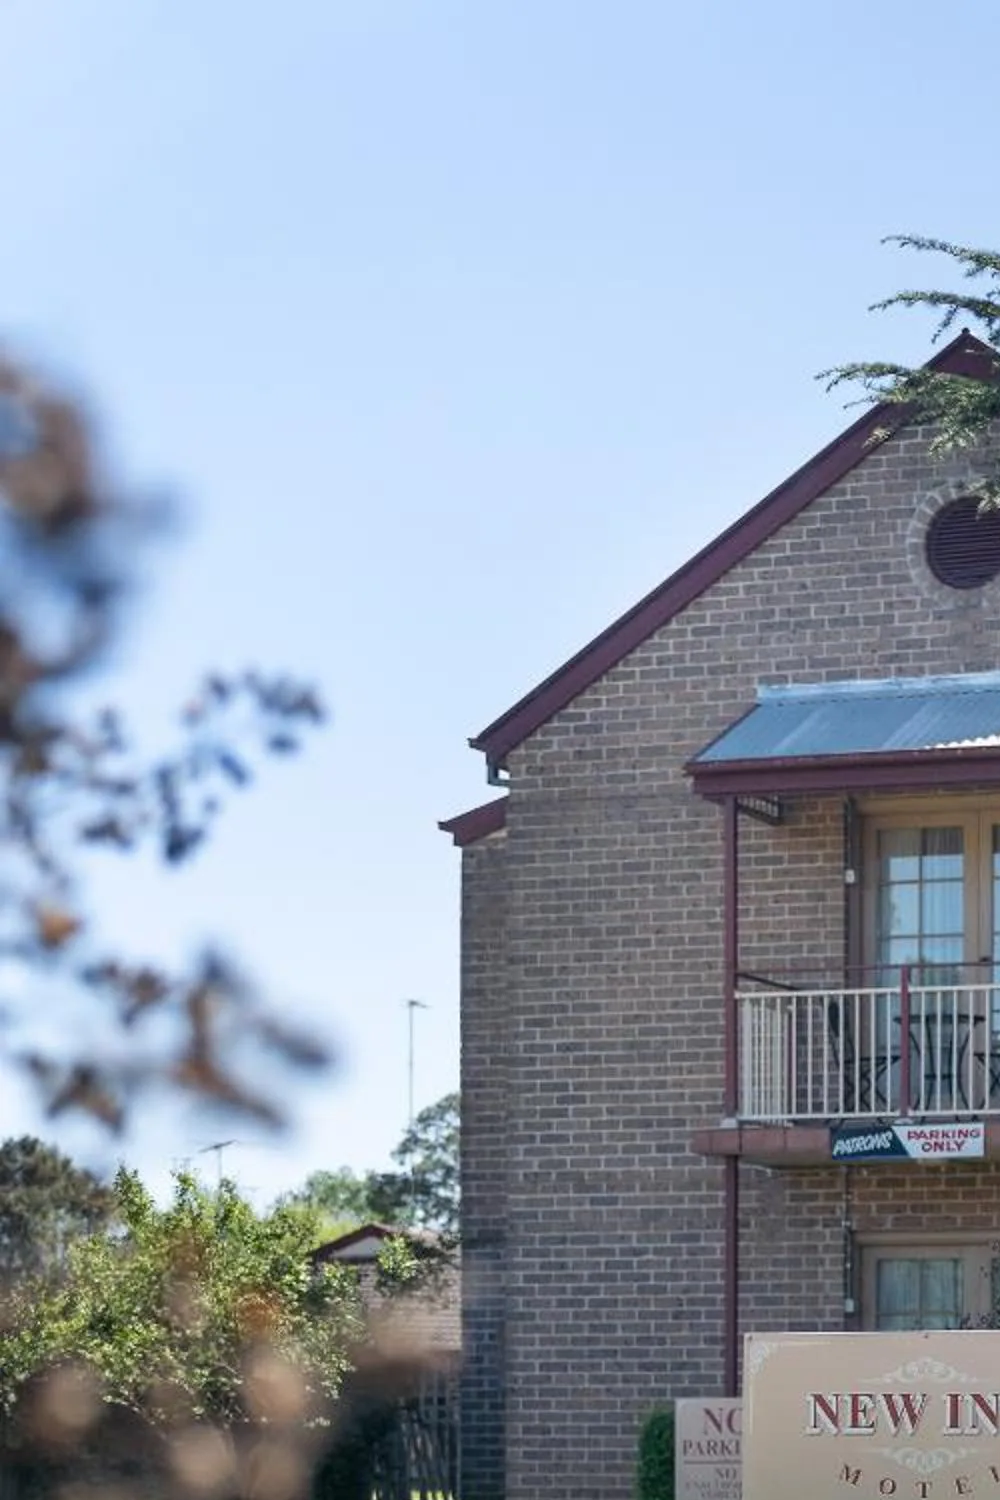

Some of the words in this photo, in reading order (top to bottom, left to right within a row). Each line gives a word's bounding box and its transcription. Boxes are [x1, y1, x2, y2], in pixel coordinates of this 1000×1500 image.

[907, 1127, 981, 1141] PARKING
[921, 1140, 965, 1153] ONLY
[806, 1392, 928, 1437] NEW
